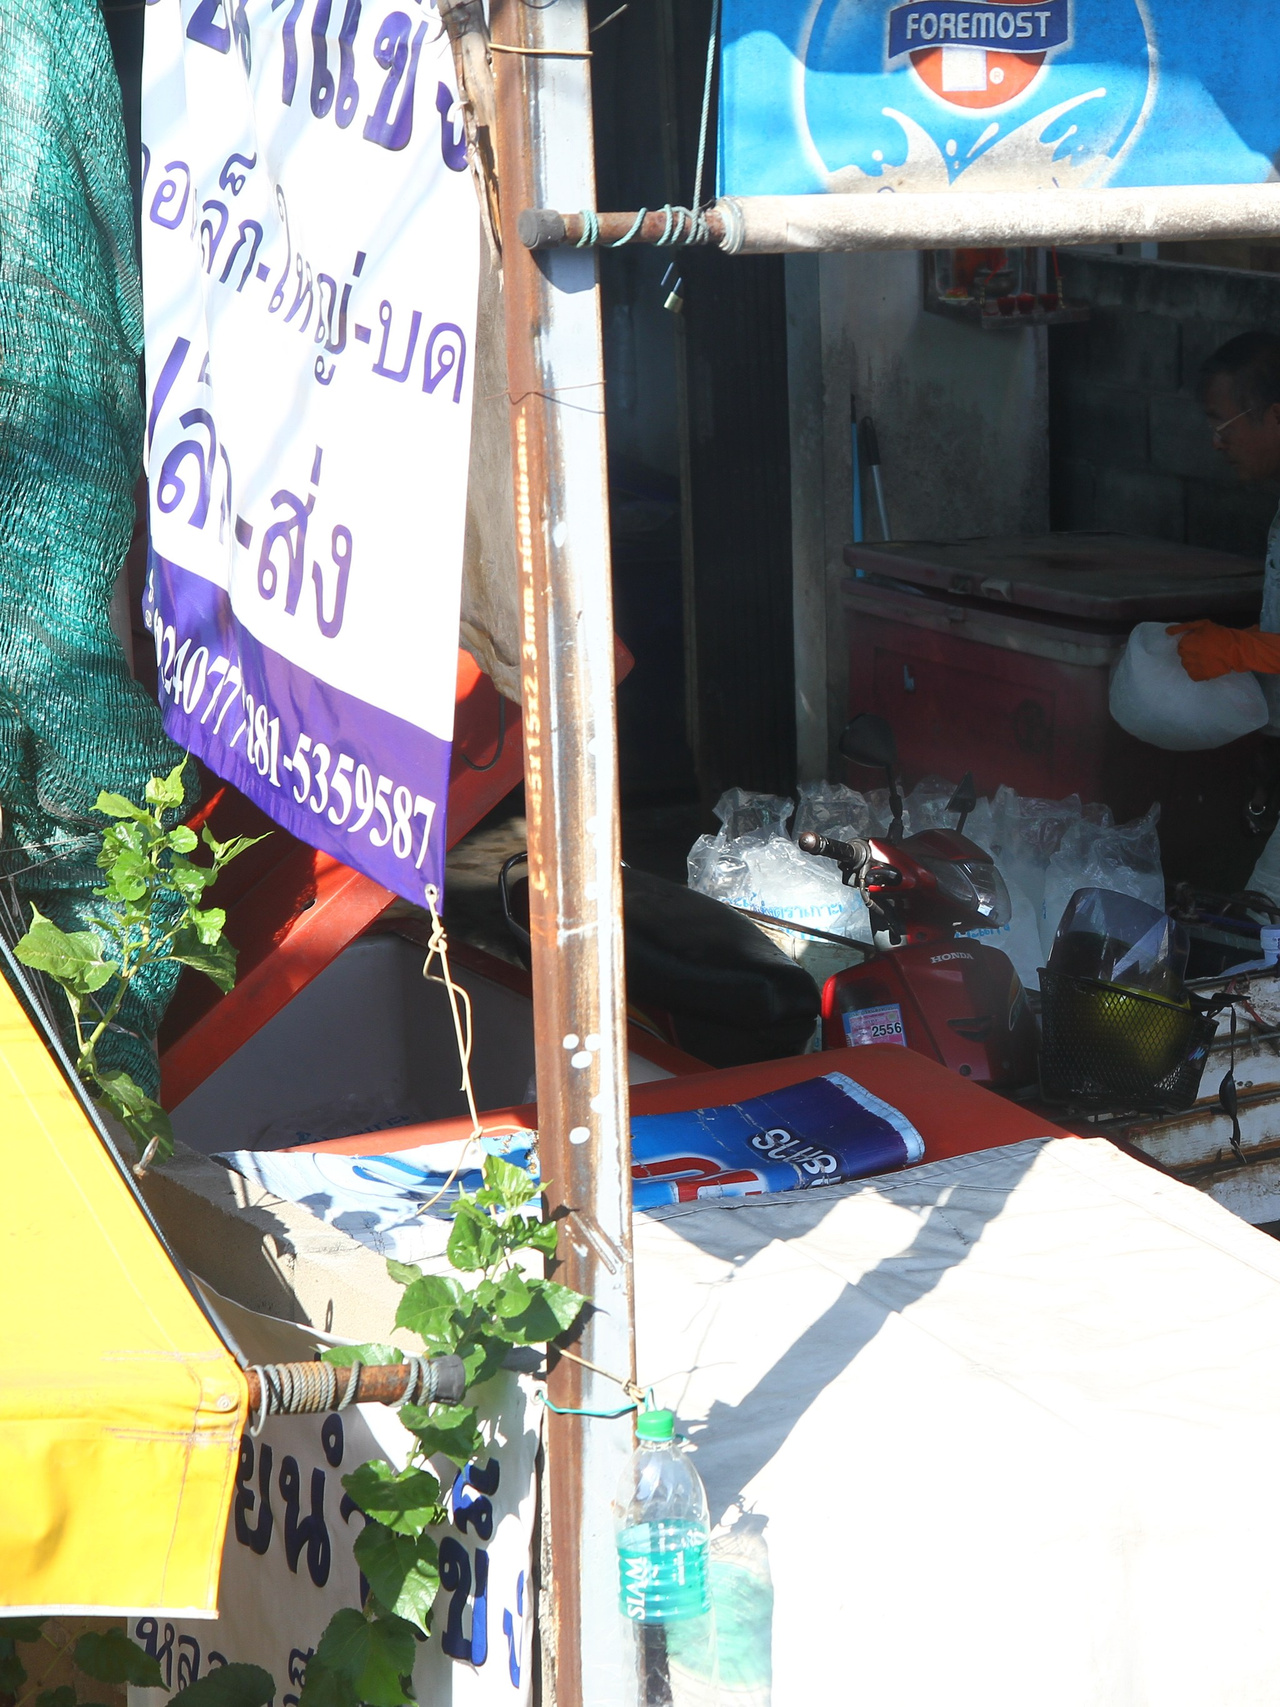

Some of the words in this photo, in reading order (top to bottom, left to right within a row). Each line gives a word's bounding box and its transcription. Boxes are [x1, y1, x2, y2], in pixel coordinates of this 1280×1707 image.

[906, 11, 1051, 41] FOREMOST
[930, 952, 974, 964] HONDA
[872, 1021, 903, 1038] 2556
[627, 1556, 647, 1620] SIAM
